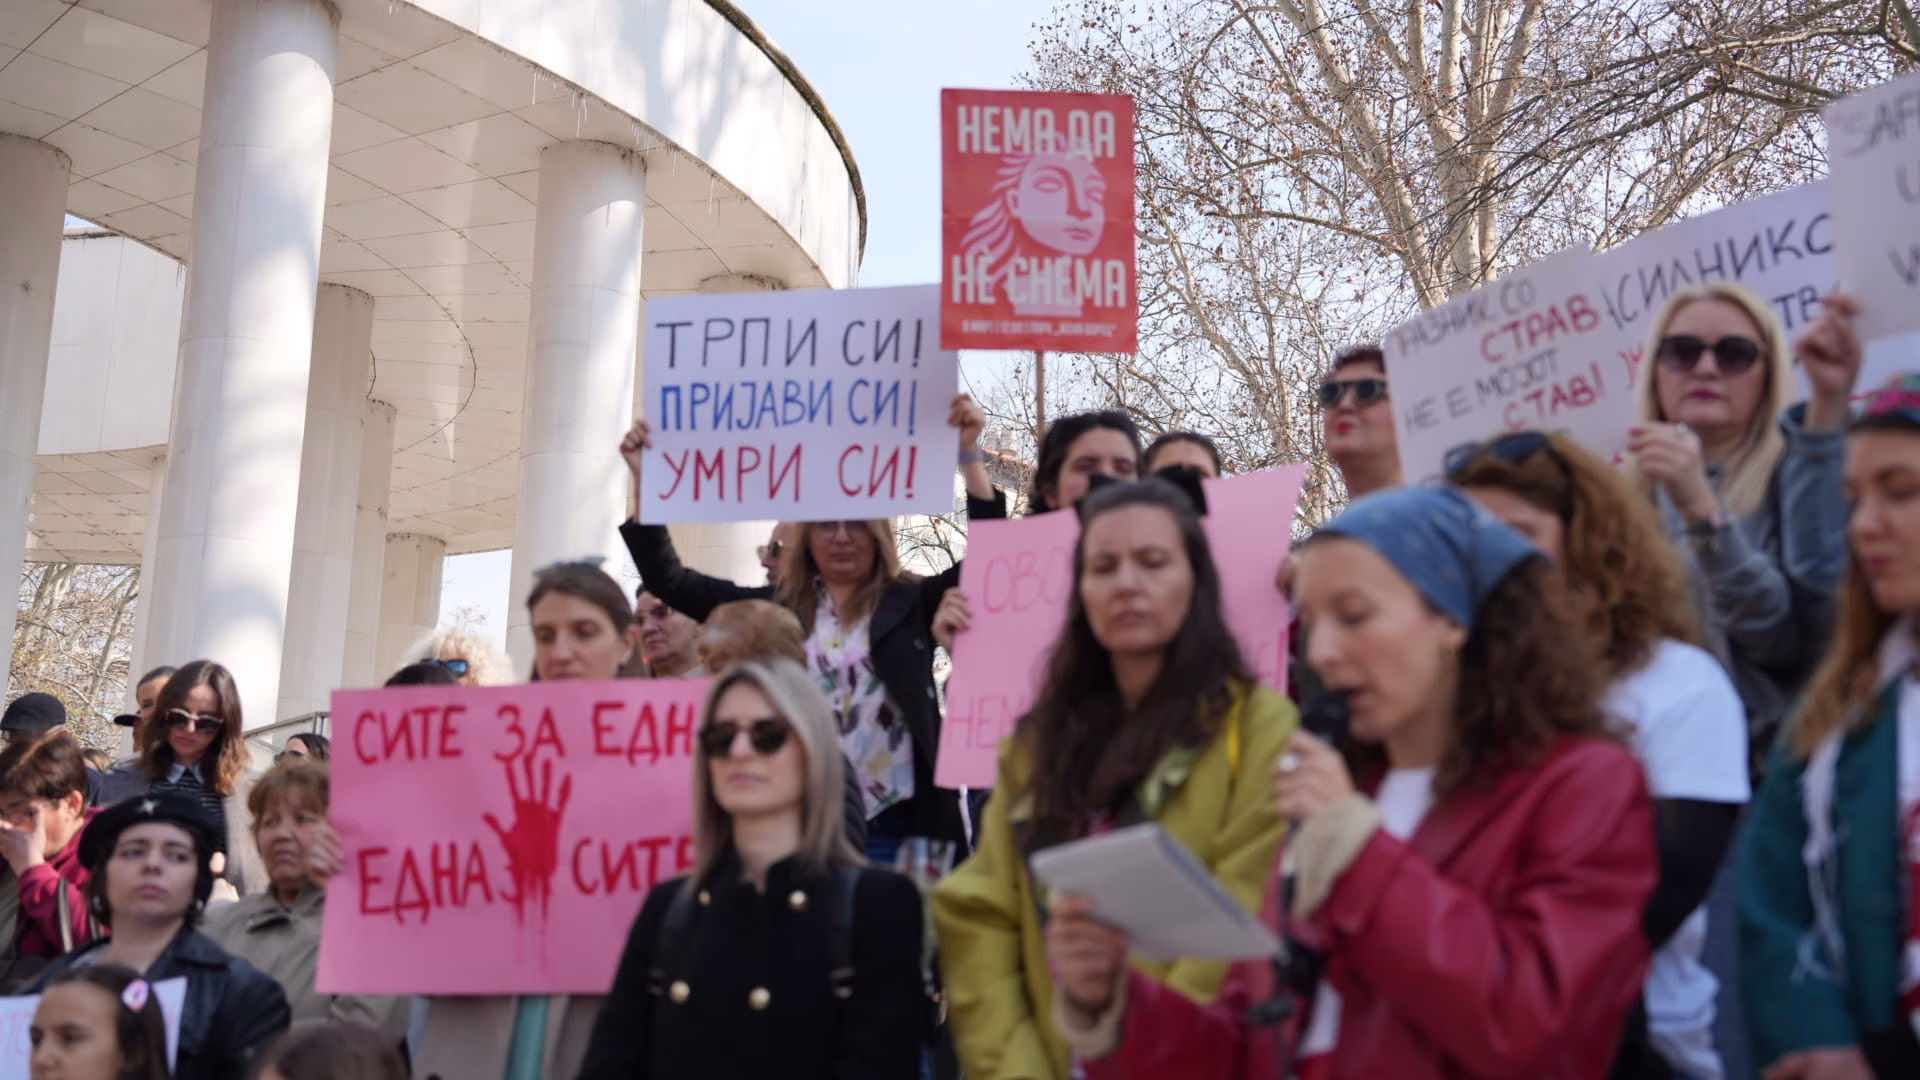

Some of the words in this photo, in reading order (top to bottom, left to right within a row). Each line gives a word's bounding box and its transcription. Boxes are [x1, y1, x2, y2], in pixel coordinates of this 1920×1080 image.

[957, 104, 1056, 155] НЕМА
[1066, 108, 1116, 163] ДА
[951, 254, 997, 304] НЕ
[1007, 255, 1128, 309] СНЕМА
[655, 316, 817, 369] ТРПИ
[842, 317, 923, 369] СИ!
[1480, 293, 1600, 364] СТРАВ
[660, 378, 834, 433] ПРИЈАВИ
[847, 377, 918, 436] СИ!
[1445, 384, 1474, 420] Е
[658, 442, 803, 503] УМРИ
[838, 443, 918, 500] СИ!
[353, 703, 467, 766] СИТЕ
[493, 703, 565, 763] ЗА
[591, 701, 694, 767] ЕДН
[356, 841, 493, 924] ЕДНА
